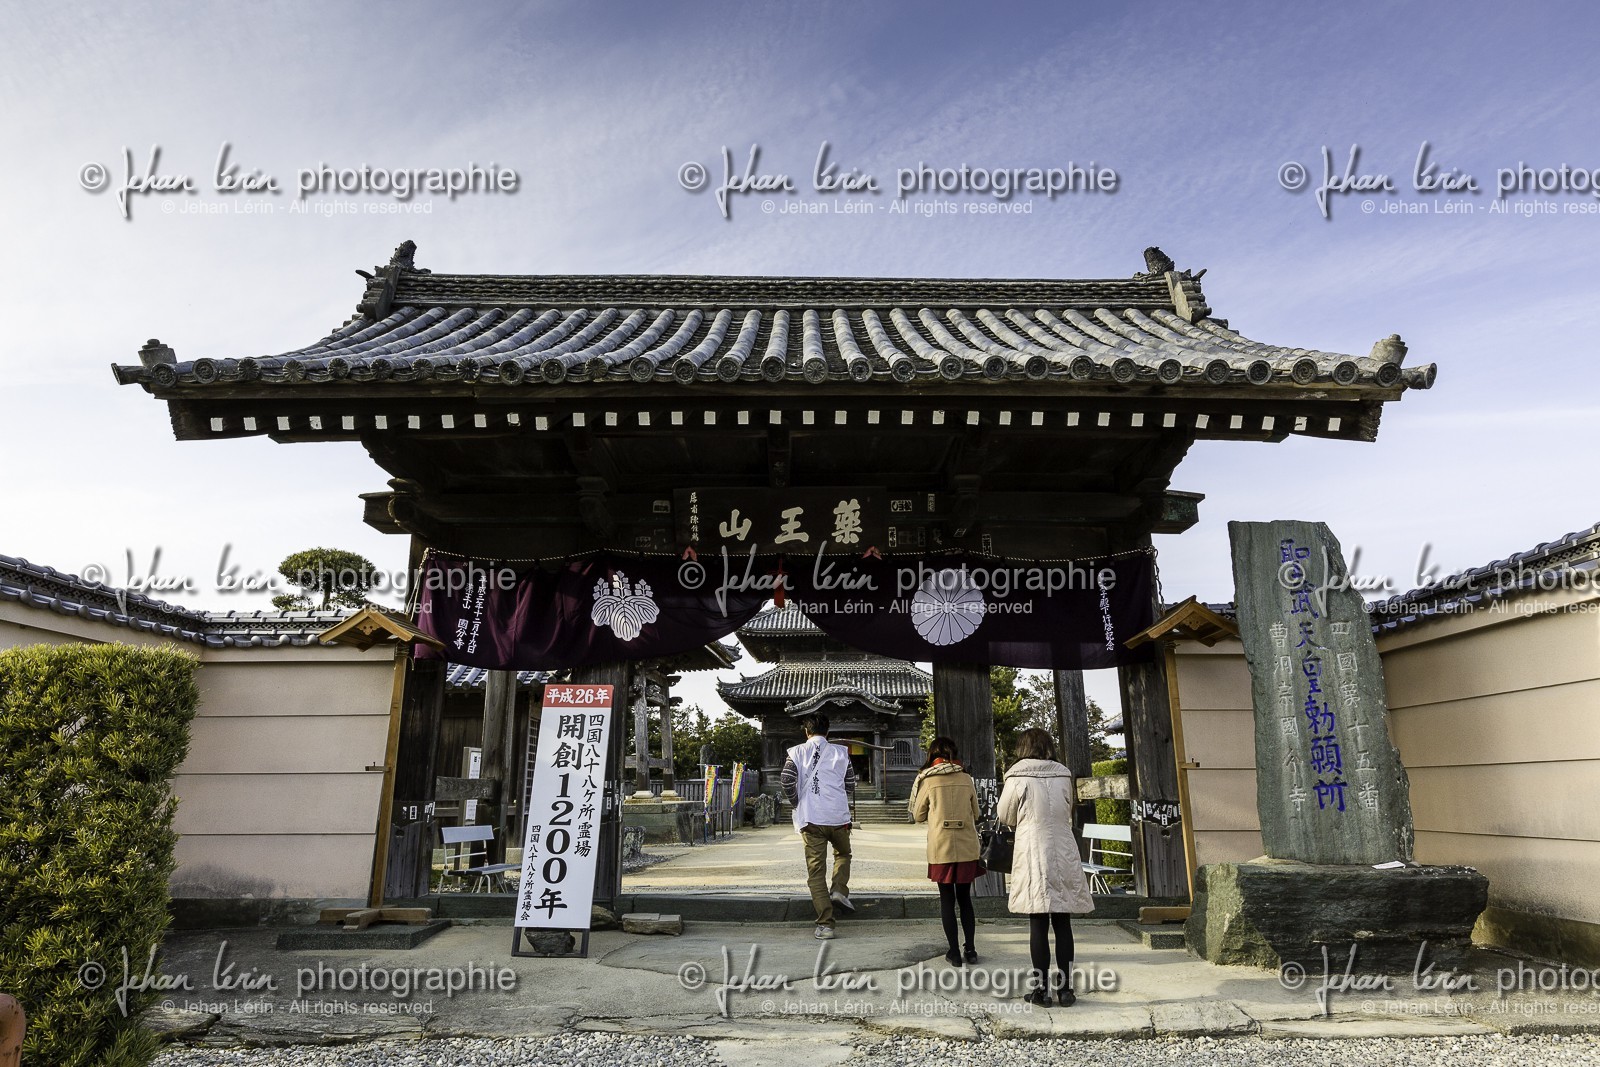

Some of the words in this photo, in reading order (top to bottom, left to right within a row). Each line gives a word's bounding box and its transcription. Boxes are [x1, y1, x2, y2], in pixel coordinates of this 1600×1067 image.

[546, 688, 610, 705] 平成26年
[533, 713, 587, 920] 開創1200年
